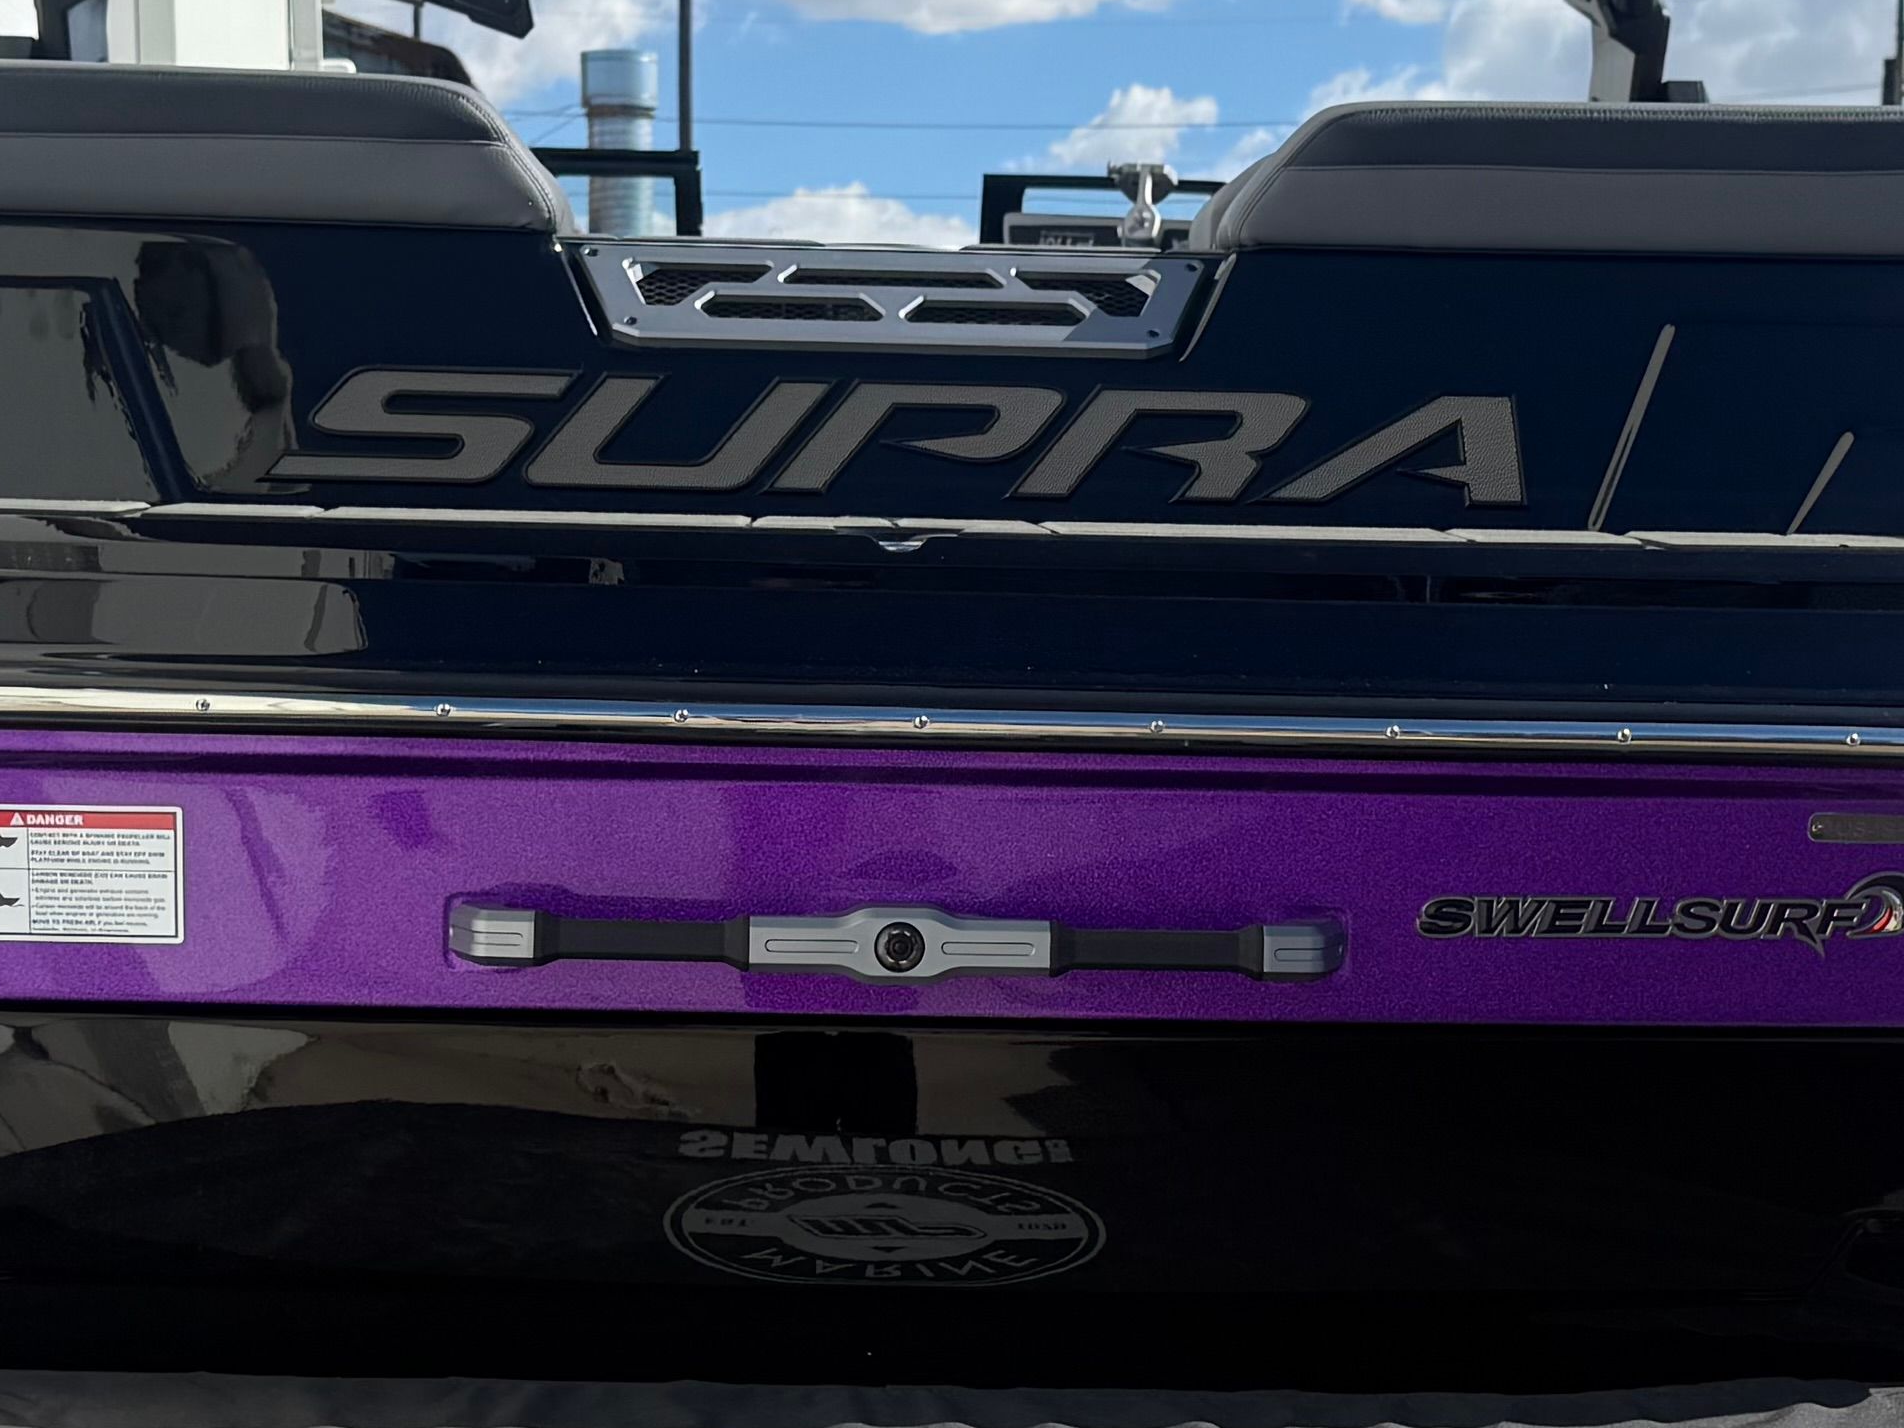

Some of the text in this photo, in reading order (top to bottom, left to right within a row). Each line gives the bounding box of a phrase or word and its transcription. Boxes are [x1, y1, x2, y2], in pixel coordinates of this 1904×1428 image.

[265, 367, 1525, 507] SUPRA
[26, 814, 84, 826] DANGER
[1416, 894, 1871, 958] SWELLSURF
